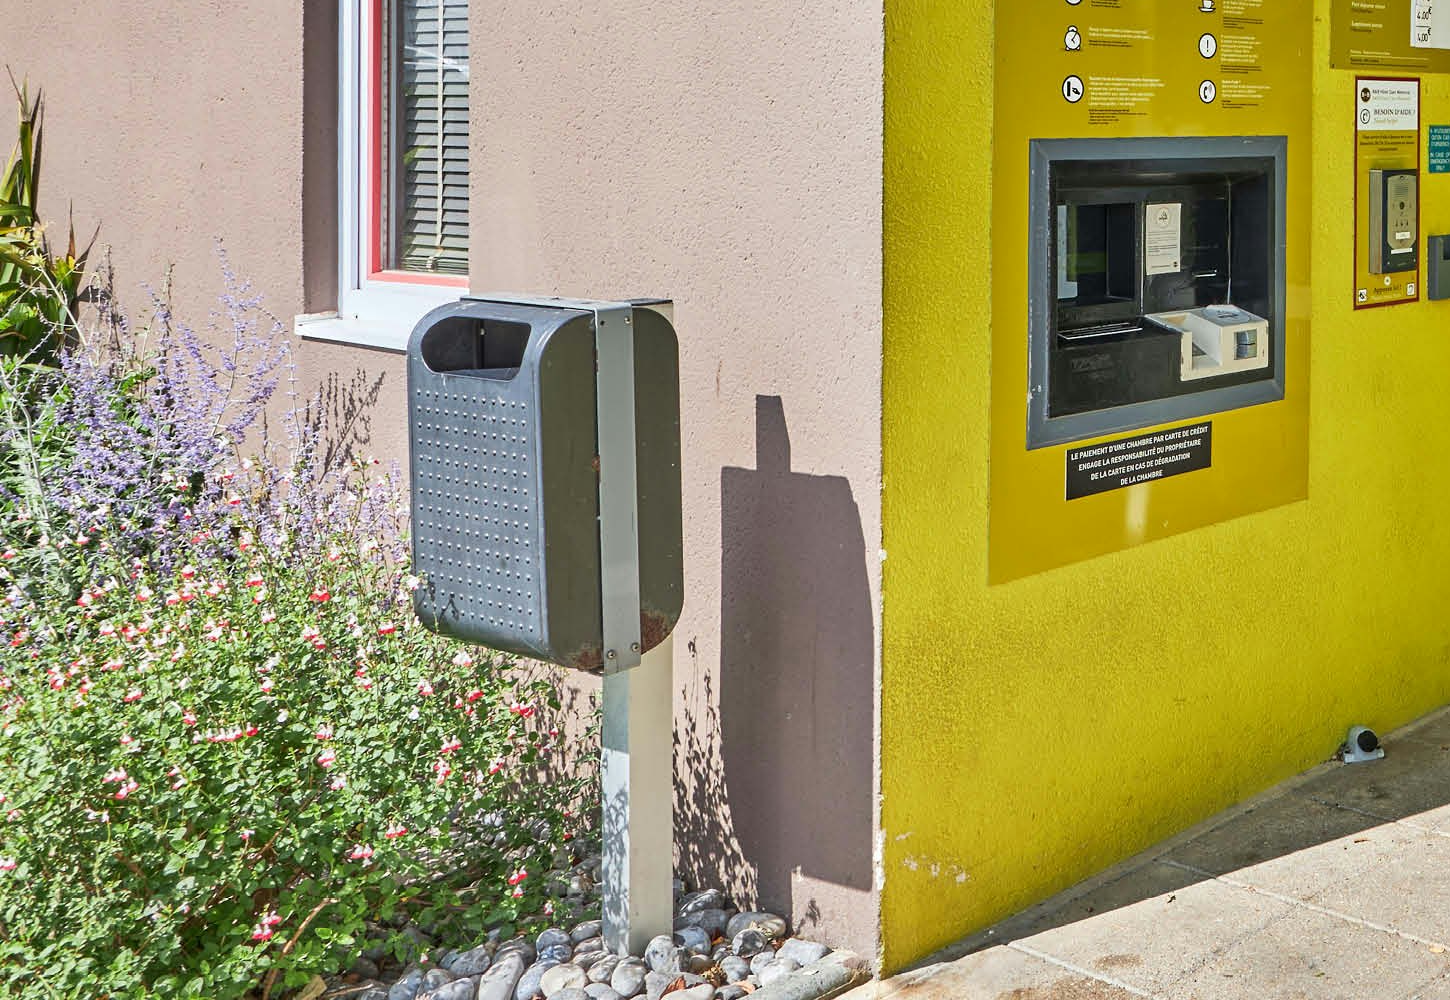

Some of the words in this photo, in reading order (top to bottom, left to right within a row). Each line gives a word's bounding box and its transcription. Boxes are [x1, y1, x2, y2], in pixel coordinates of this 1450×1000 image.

[1079, 460, 1102, 471] ENGAGE
[1102, 458, 1110, 466] LA
[1111, 447, 1156, 464] RESPONSABILITÉ
[1165, 438, 1201, 453] PROPRIÉTAIRE
[1080, 446, 1108, 459] PAIEMENT
[1109, 443, 1126, 453] D'UNE
[1126, 437, 1153, 449] CHAMBRE
[1153, 435, 1164, 443] PAR
[1165, 432, 1182, 441] CARTE
[1190, 426, 1208, 436] CRÉDIT
[1090, 472, 1099, 481] DE
[1100, 471, 1107, 479] LA
[1108, 466, 1126, 476] CARTE
[1126, 464, 1135, 473] EN
[1135, 462, 1146, 471] CAS
[1146, 460, 1154, 468] DE
[1154, 452, 1191, 466] DÉGRADATION
[1120, 477, 1128, 486] DE
[1129, 475, 1136, 484] LA
[1136, 469, 1163, 482] CHAMBRE
